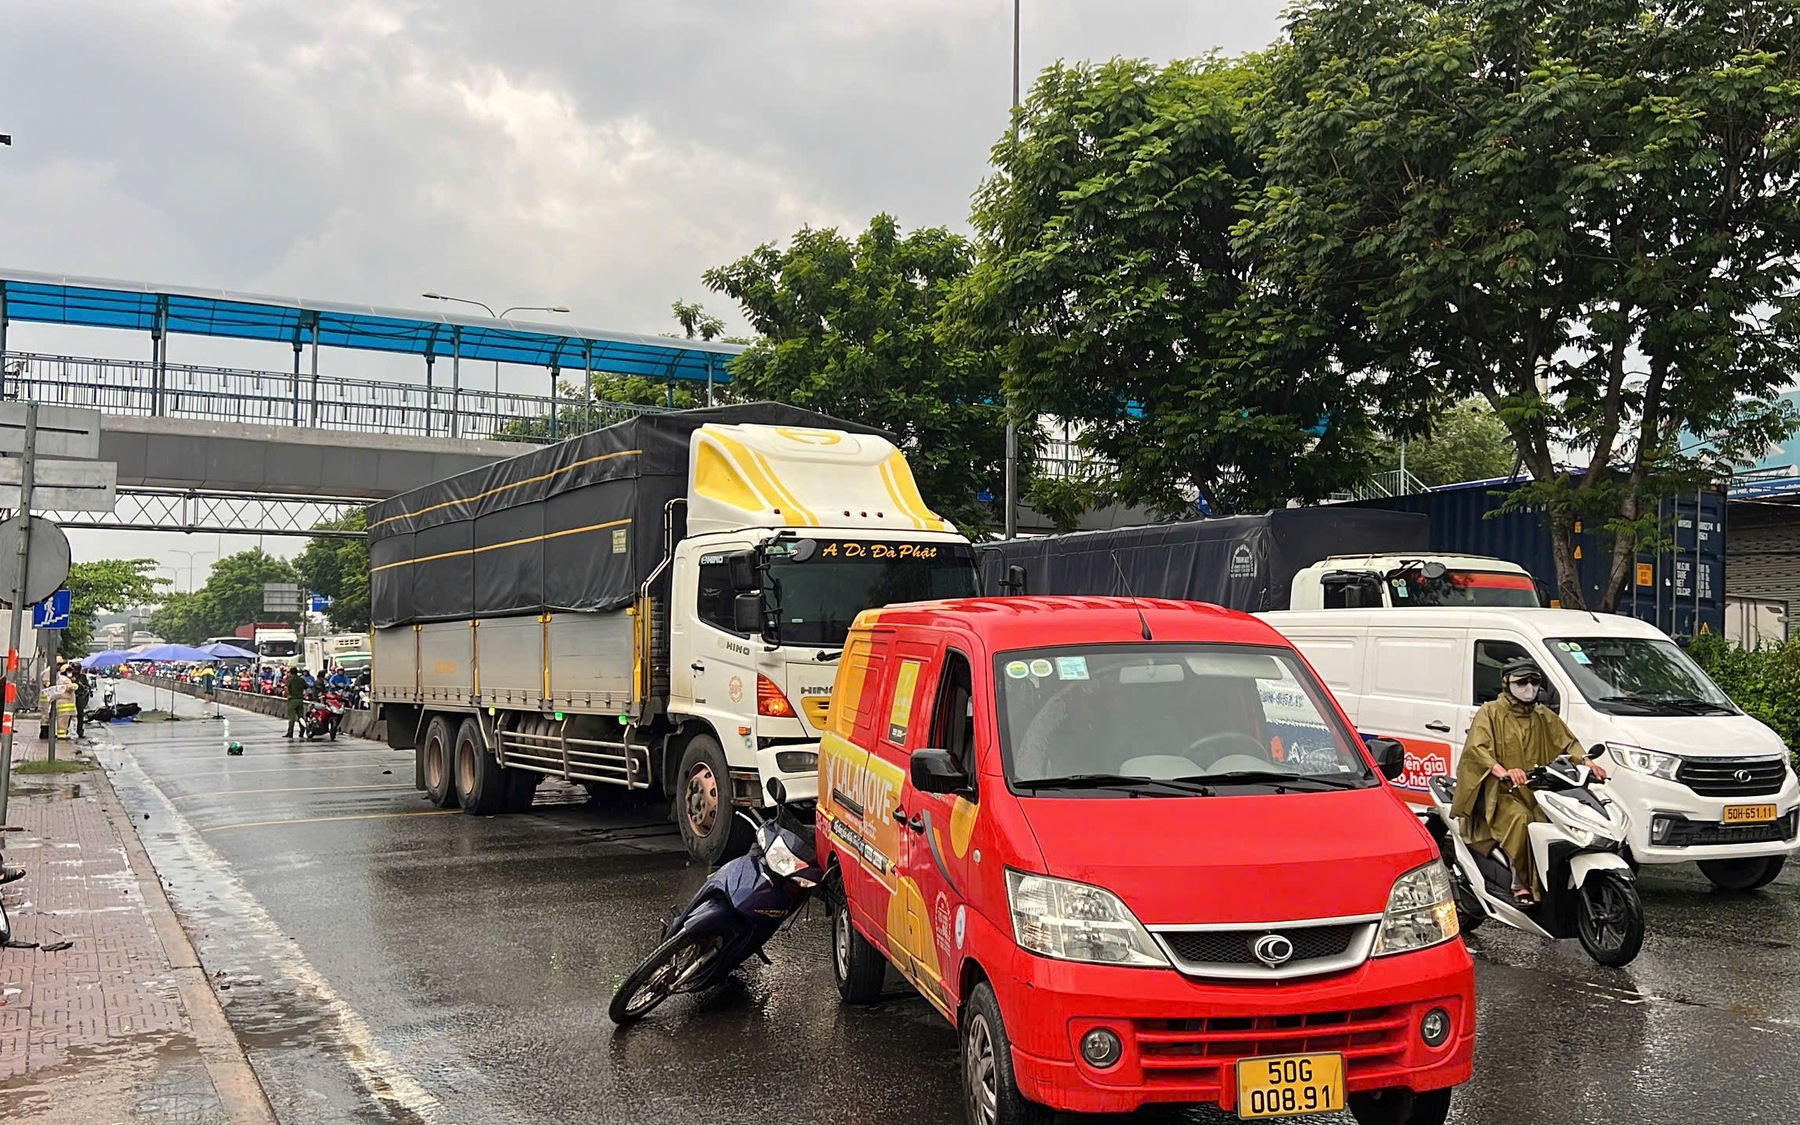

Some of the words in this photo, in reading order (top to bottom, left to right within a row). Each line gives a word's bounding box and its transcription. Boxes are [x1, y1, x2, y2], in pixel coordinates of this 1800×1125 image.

[822, 543, 838, 557] A
[843, 543, 867, 558] Di
[870, 544, 897, 558] Đà
[898, 544, 937, 560] Phật
[726, 641, 750, 656] HINO
[1423, 757, 1444, 775] gia
[836, 753, 893, 826] LALAMOVE
[1727, 806, 1772, 820] 50H-651.11
[1268, 1059, 1313, 1085] 50G
[1251, 1085, 1330, 1114] 008.91
